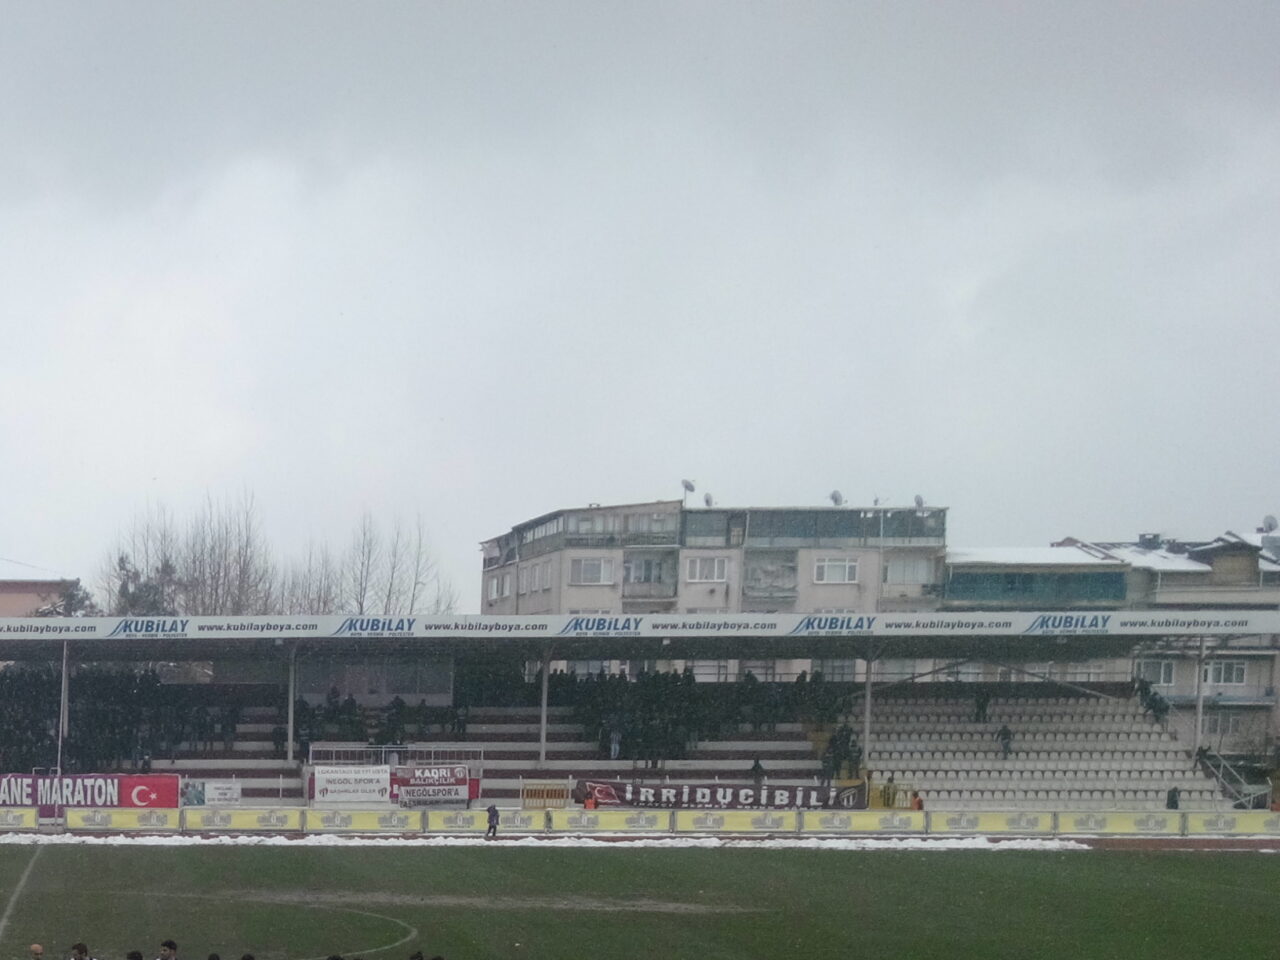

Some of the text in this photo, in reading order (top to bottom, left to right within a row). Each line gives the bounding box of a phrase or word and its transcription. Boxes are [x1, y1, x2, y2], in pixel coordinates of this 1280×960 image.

[198, 622, 317, 632] www.kubilayboya.com
[424, 621, 548, 632] www.kubilayboya.com
[652, 621, 776, 631] www.kubilayboya.com
[885, 620, 1012, 630] www.kubilayboya.com
[1120, 619, 1248, 628] www.kubilayboya.com
[37, 777, 119, 806] MARATON
